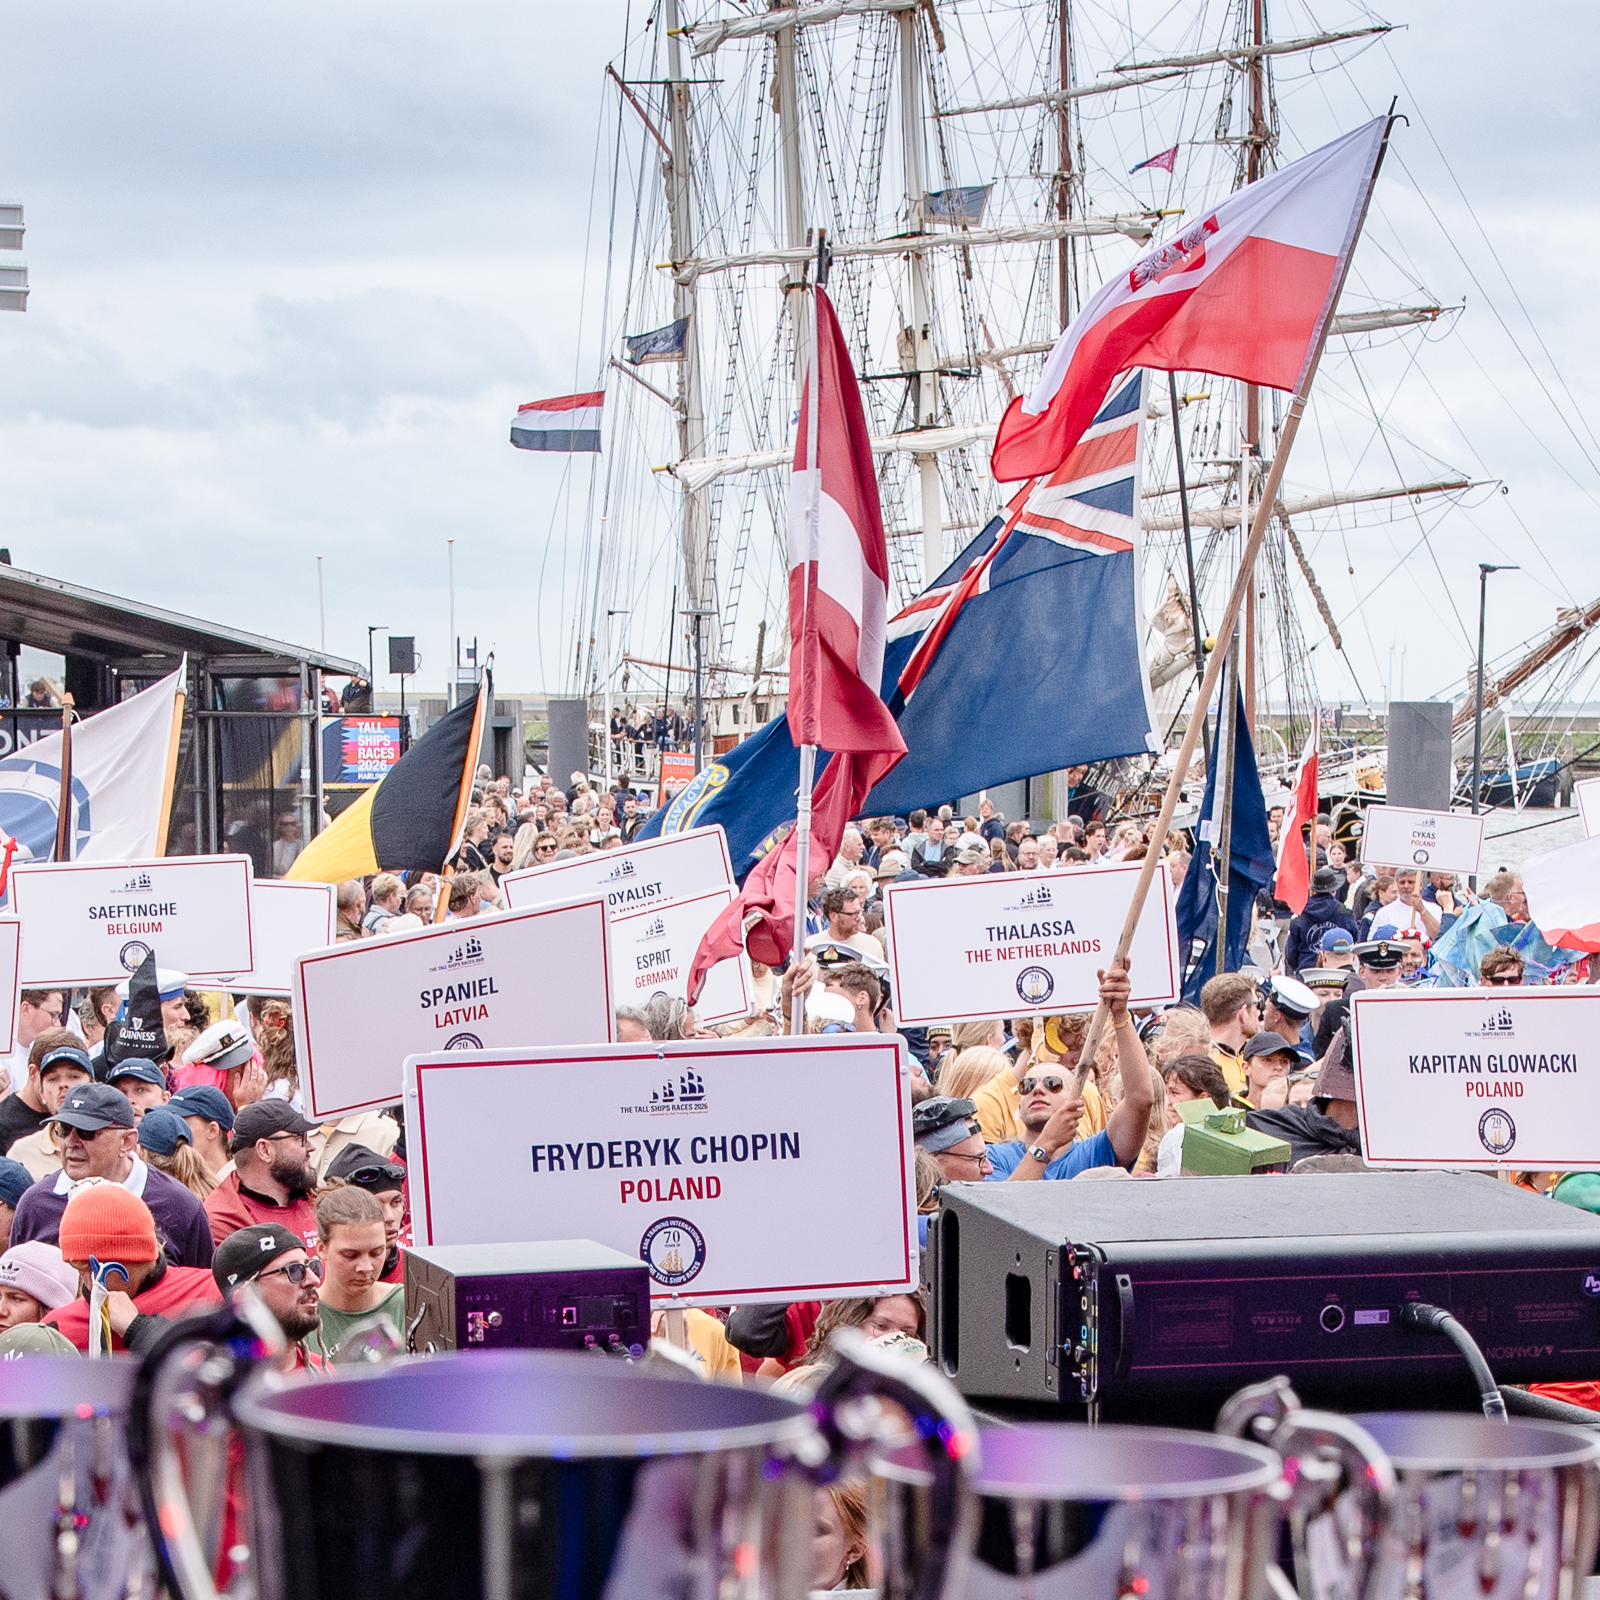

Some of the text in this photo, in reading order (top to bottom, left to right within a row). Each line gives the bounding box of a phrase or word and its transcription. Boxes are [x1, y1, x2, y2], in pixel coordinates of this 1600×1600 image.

[357, 721, 384, 734] TALL
[357, 734, 391, 747] SHIPS
[357, 747, 395, 760] RACES
[357, 759, 387, 772] 2026
[1410, 839, 1436, 848] POLAND
[608, 882, 662, 906] OYALIST
[88, 902, 177, 920] SAEFTINGHE
[107, 921, 163, 935] BELGIUM
[985, 919, 1076, 942] THALASSA
[636, 948, 672, 970] ESPRIT
[965, 939, 1102, 964] THE NETHERLANDS
[634, 967, 680, 989] GERMANY
[420, 976, 499, 1009] SPANIEL
[435, 1003, 489, 1029] LATVIA
[119, 1027, 157, 1042] GUINNESS
[1409, 1053, 1578, 1074] KAPITAN GLOWACKI
[1465, 1081, 1524, 1098] POLAND
[620, 1106, 633, 1114] THE
[650, 1104, 670, 1112] SHIPS
[671, 1103, 693, 1111] RACES
[531, 1131, 801, 1173] FRYDERYK CHOPIN
[620, 1175, 722, 1204] POLAND
[663, 1230, 681, 1244] 70
